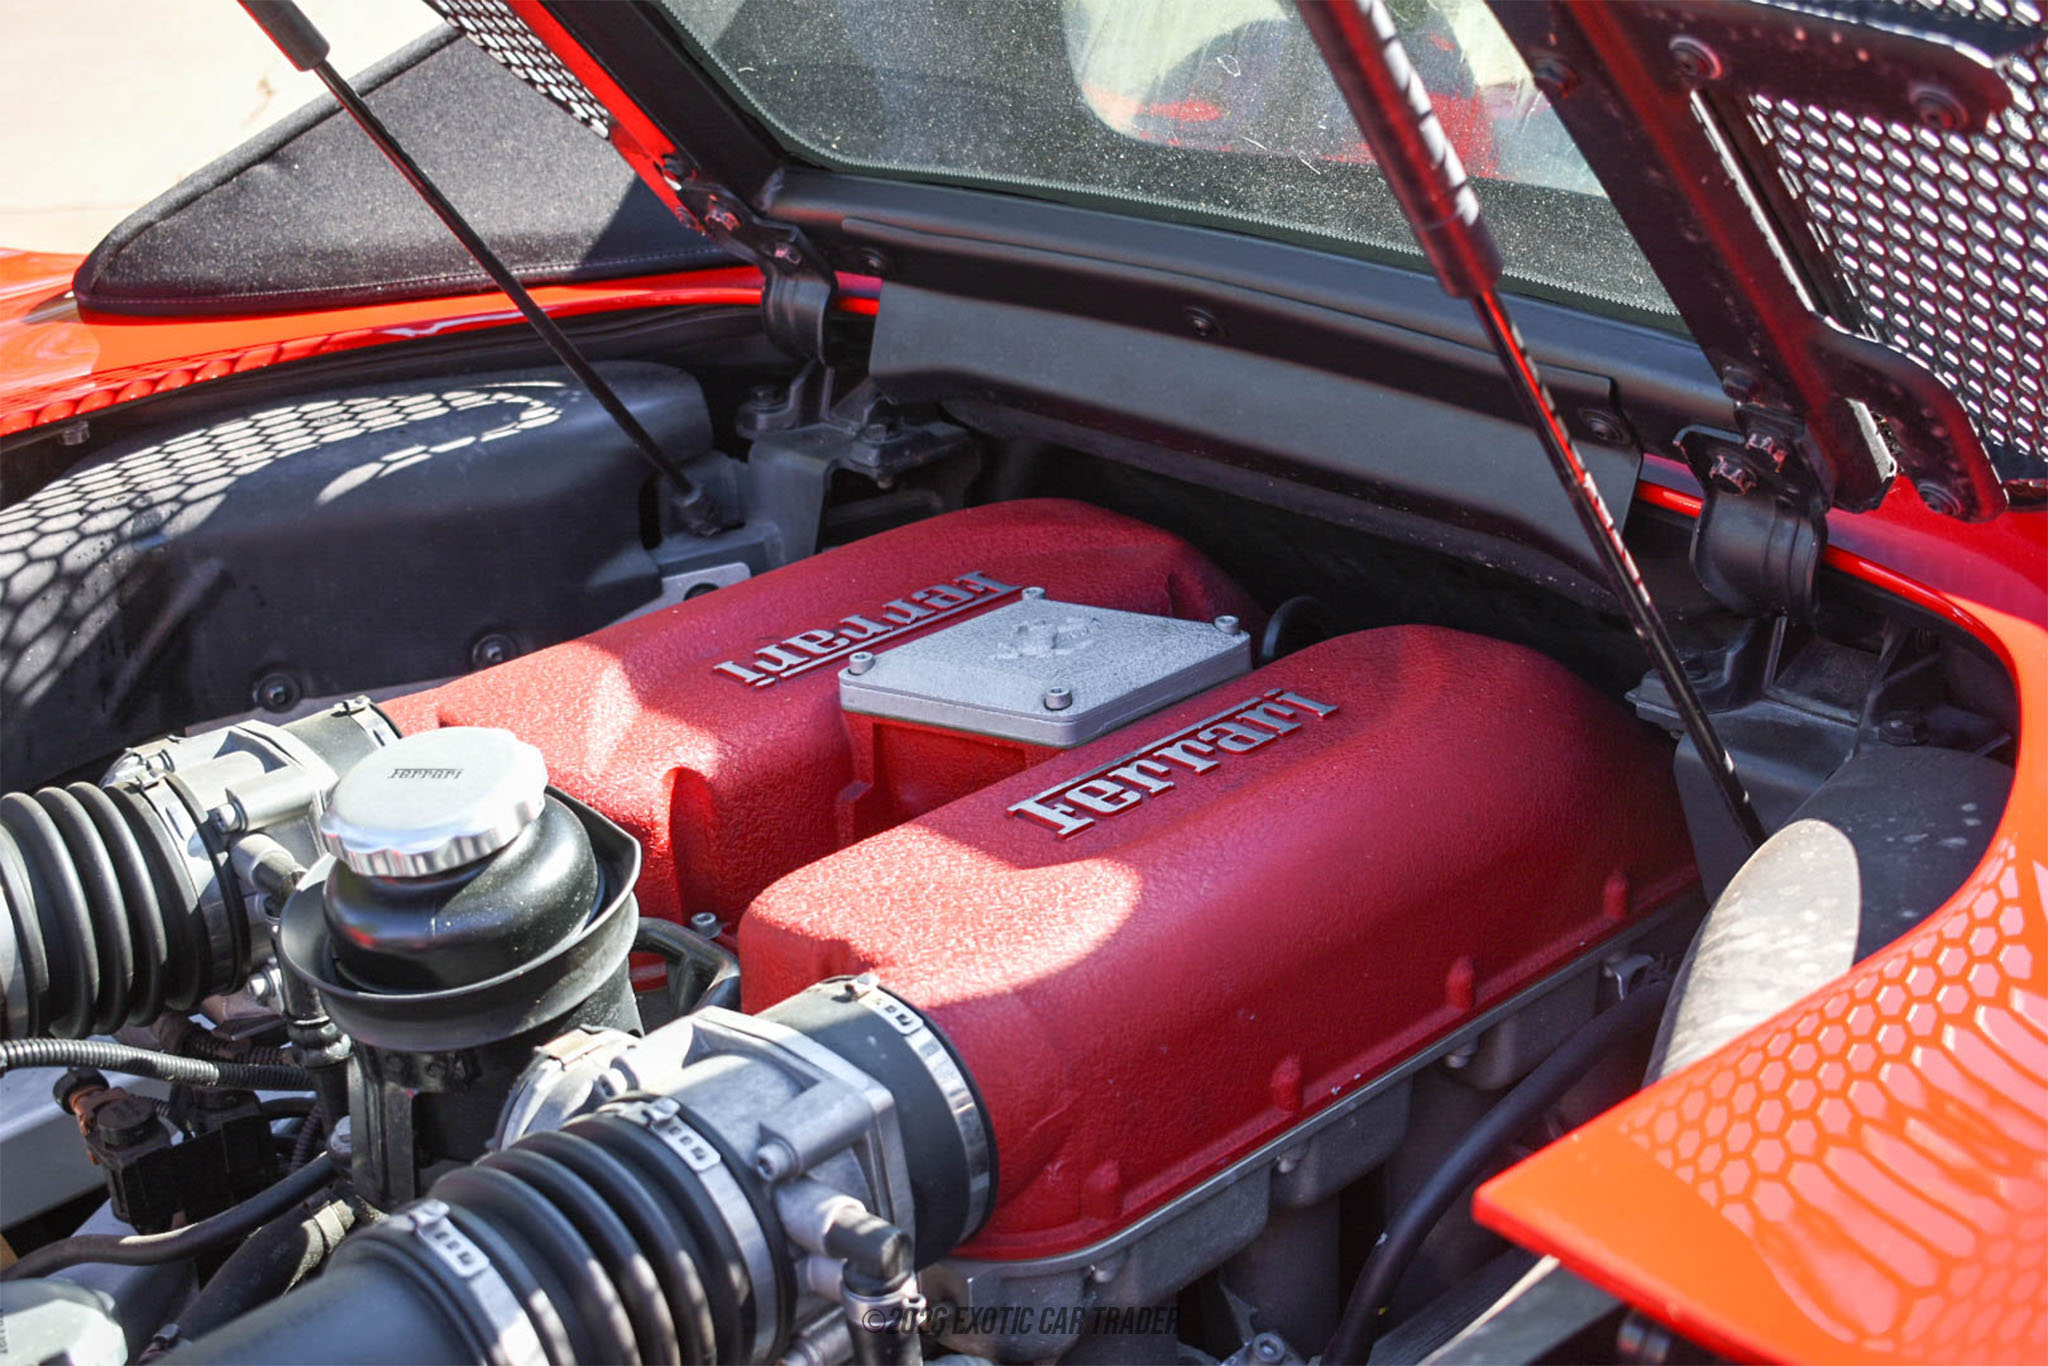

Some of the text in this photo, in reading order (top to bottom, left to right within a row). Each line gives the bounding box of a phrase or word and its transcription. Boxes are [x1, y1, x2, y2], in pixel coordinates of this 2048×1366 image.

[713, 570, 1023, 688] Ferrari
[386, 767, 464, 780] Ferrari
[1006, 688, 1340, 840] Ferrari
